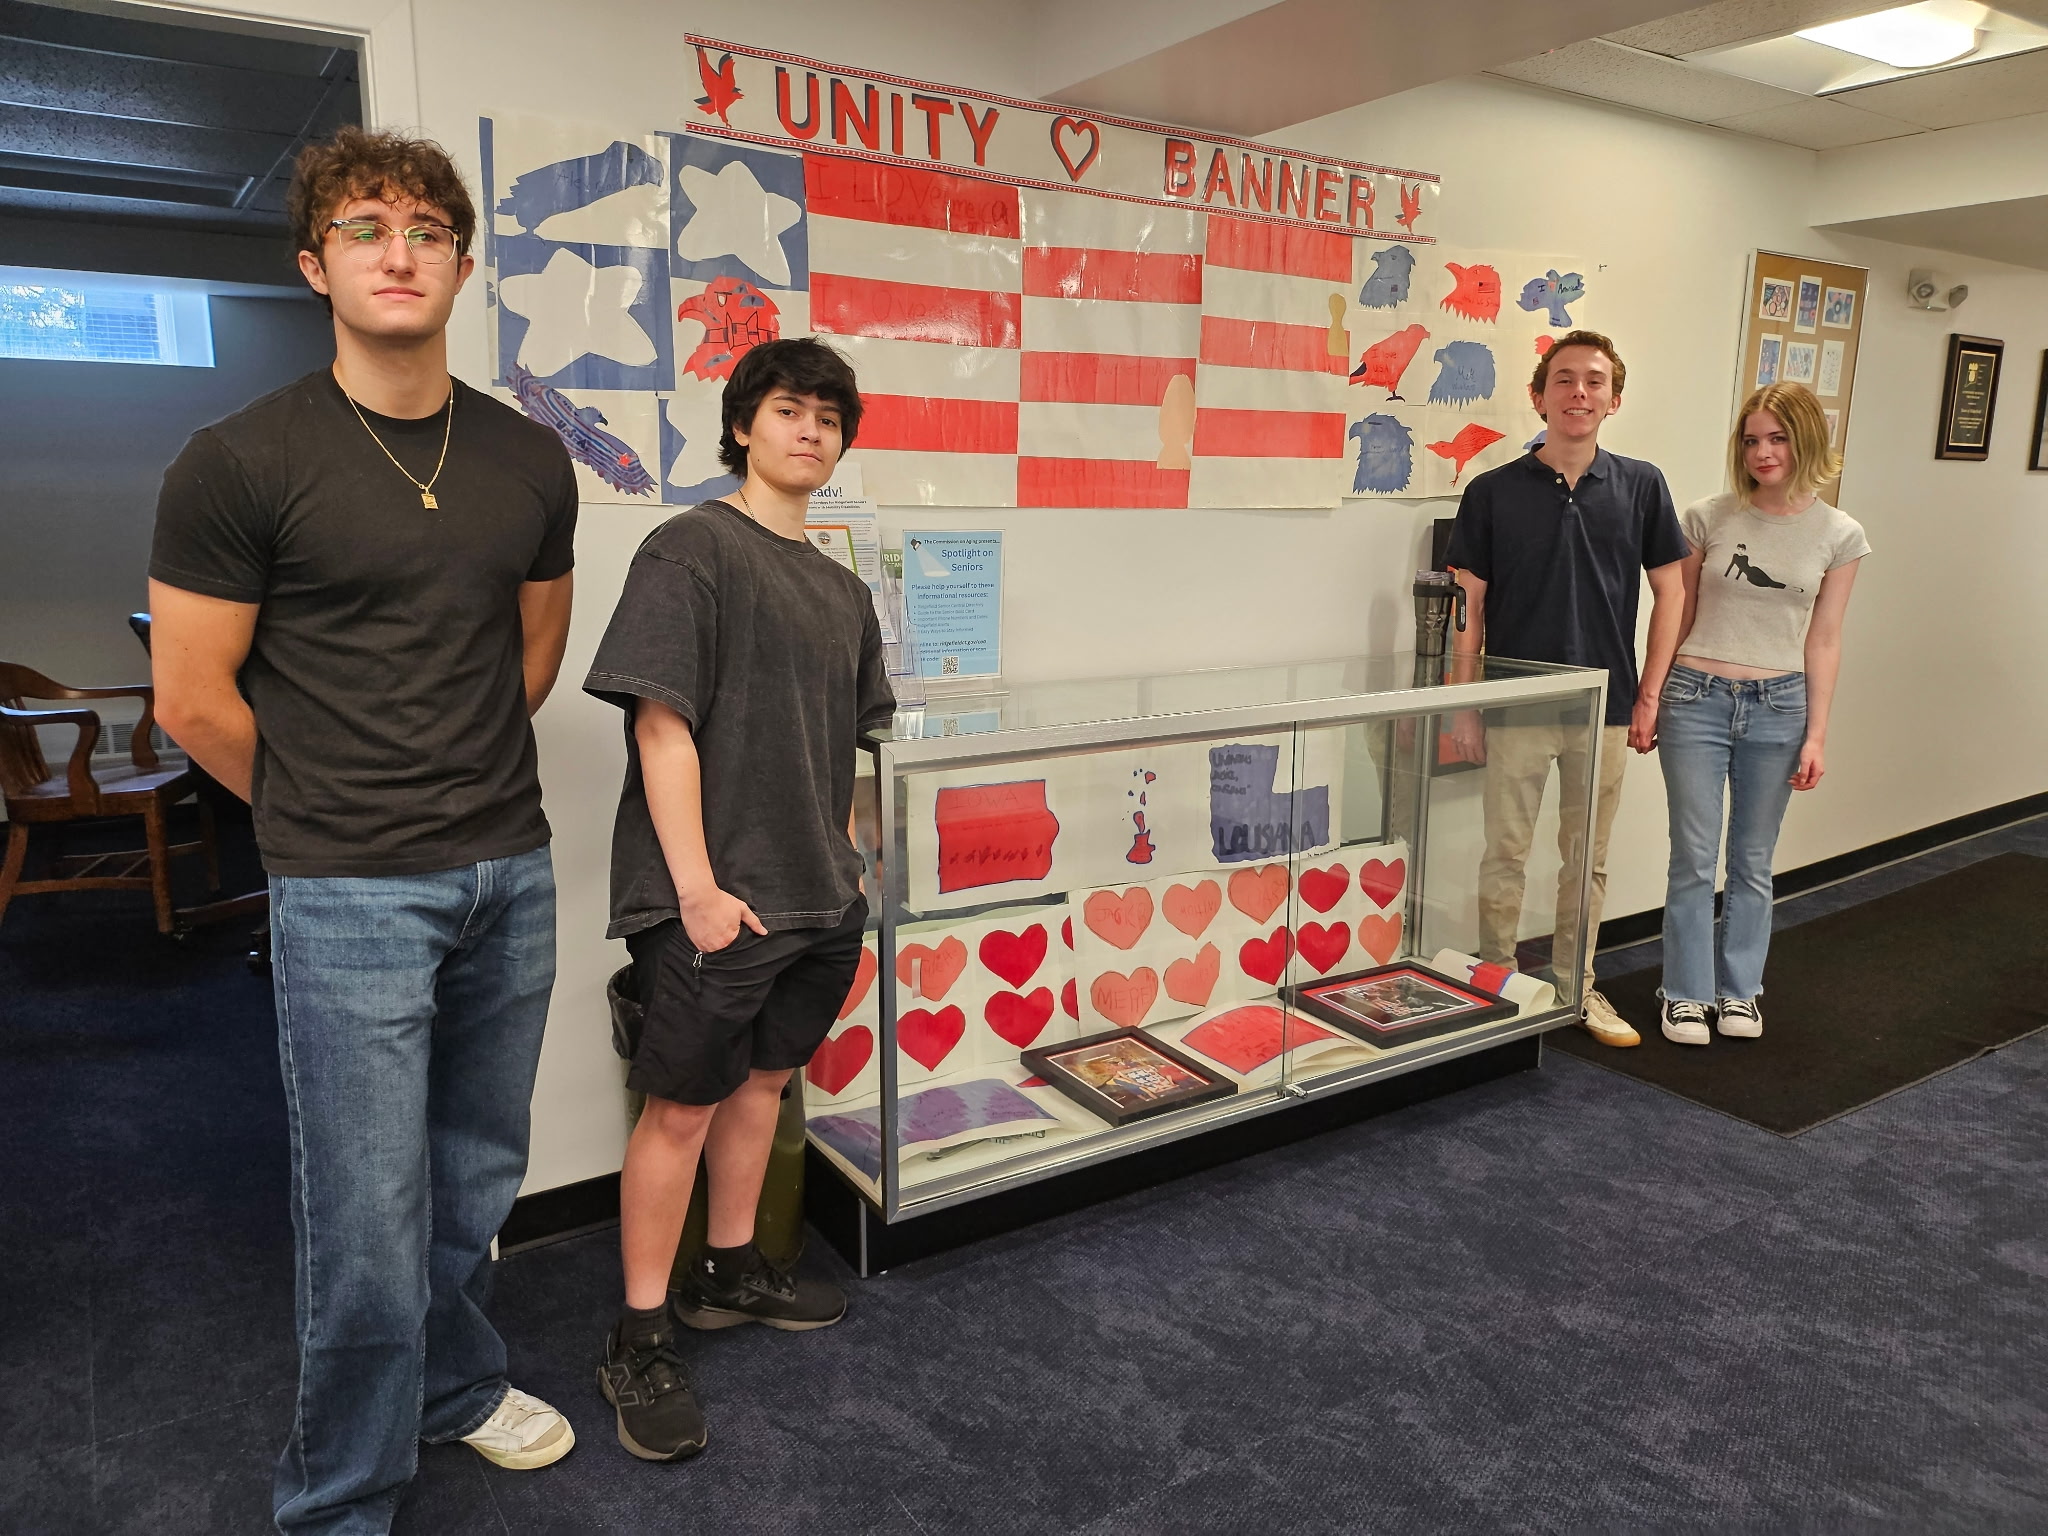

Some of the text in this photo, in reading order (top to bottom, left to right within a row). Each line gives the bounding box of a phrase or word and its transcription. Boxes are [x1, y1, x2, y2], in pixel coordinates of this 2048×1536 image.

[775, 66, 1376, 231] UNITY BANNER
[1372, 348, 1396, 359] I love
[1373, 364, 1389, 372] USA
[942, 549, 980, 559] Spotlight
[952, 563, 983, 571] Seniors
